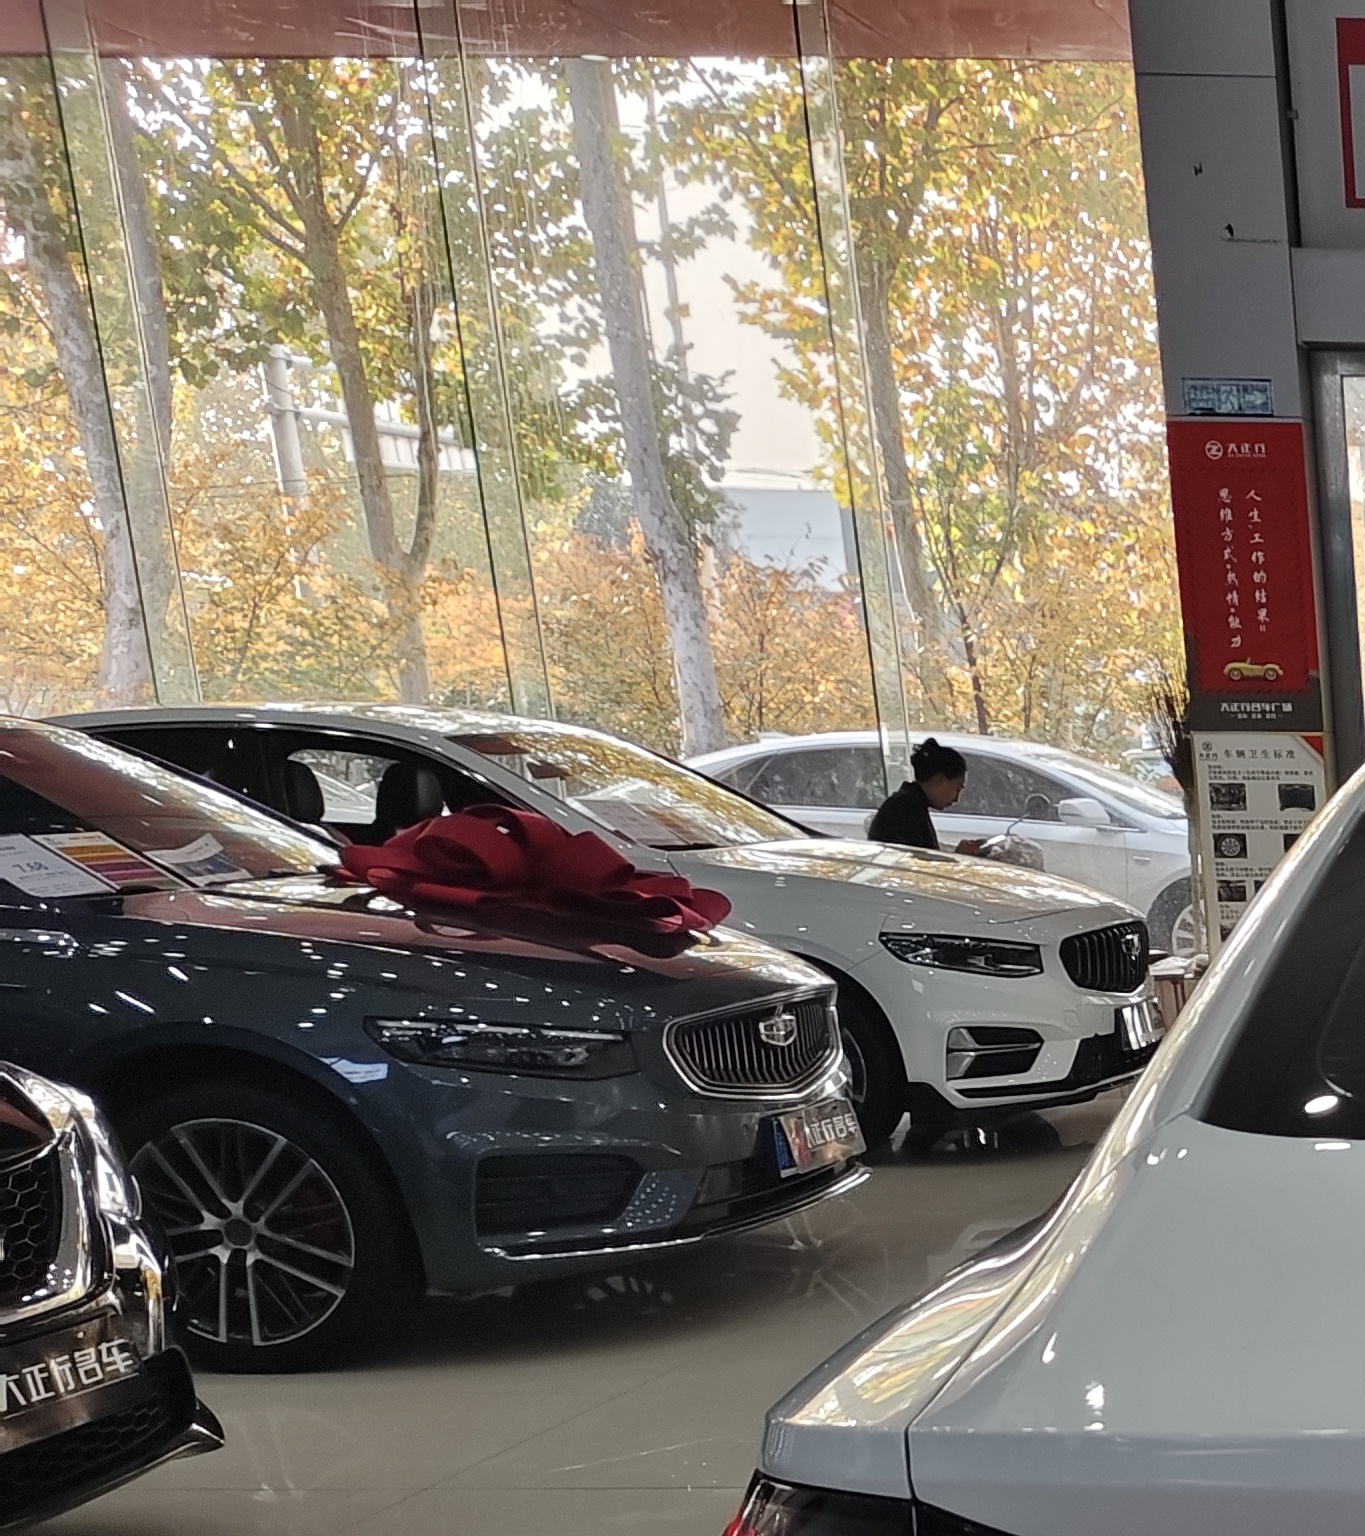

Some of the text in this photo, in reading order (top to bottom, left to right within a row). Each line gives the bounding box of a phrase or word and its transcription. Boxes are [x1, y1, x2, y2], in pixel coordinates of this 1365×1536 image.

[1223, 748, 1297, 760] 车辆卫生标准
